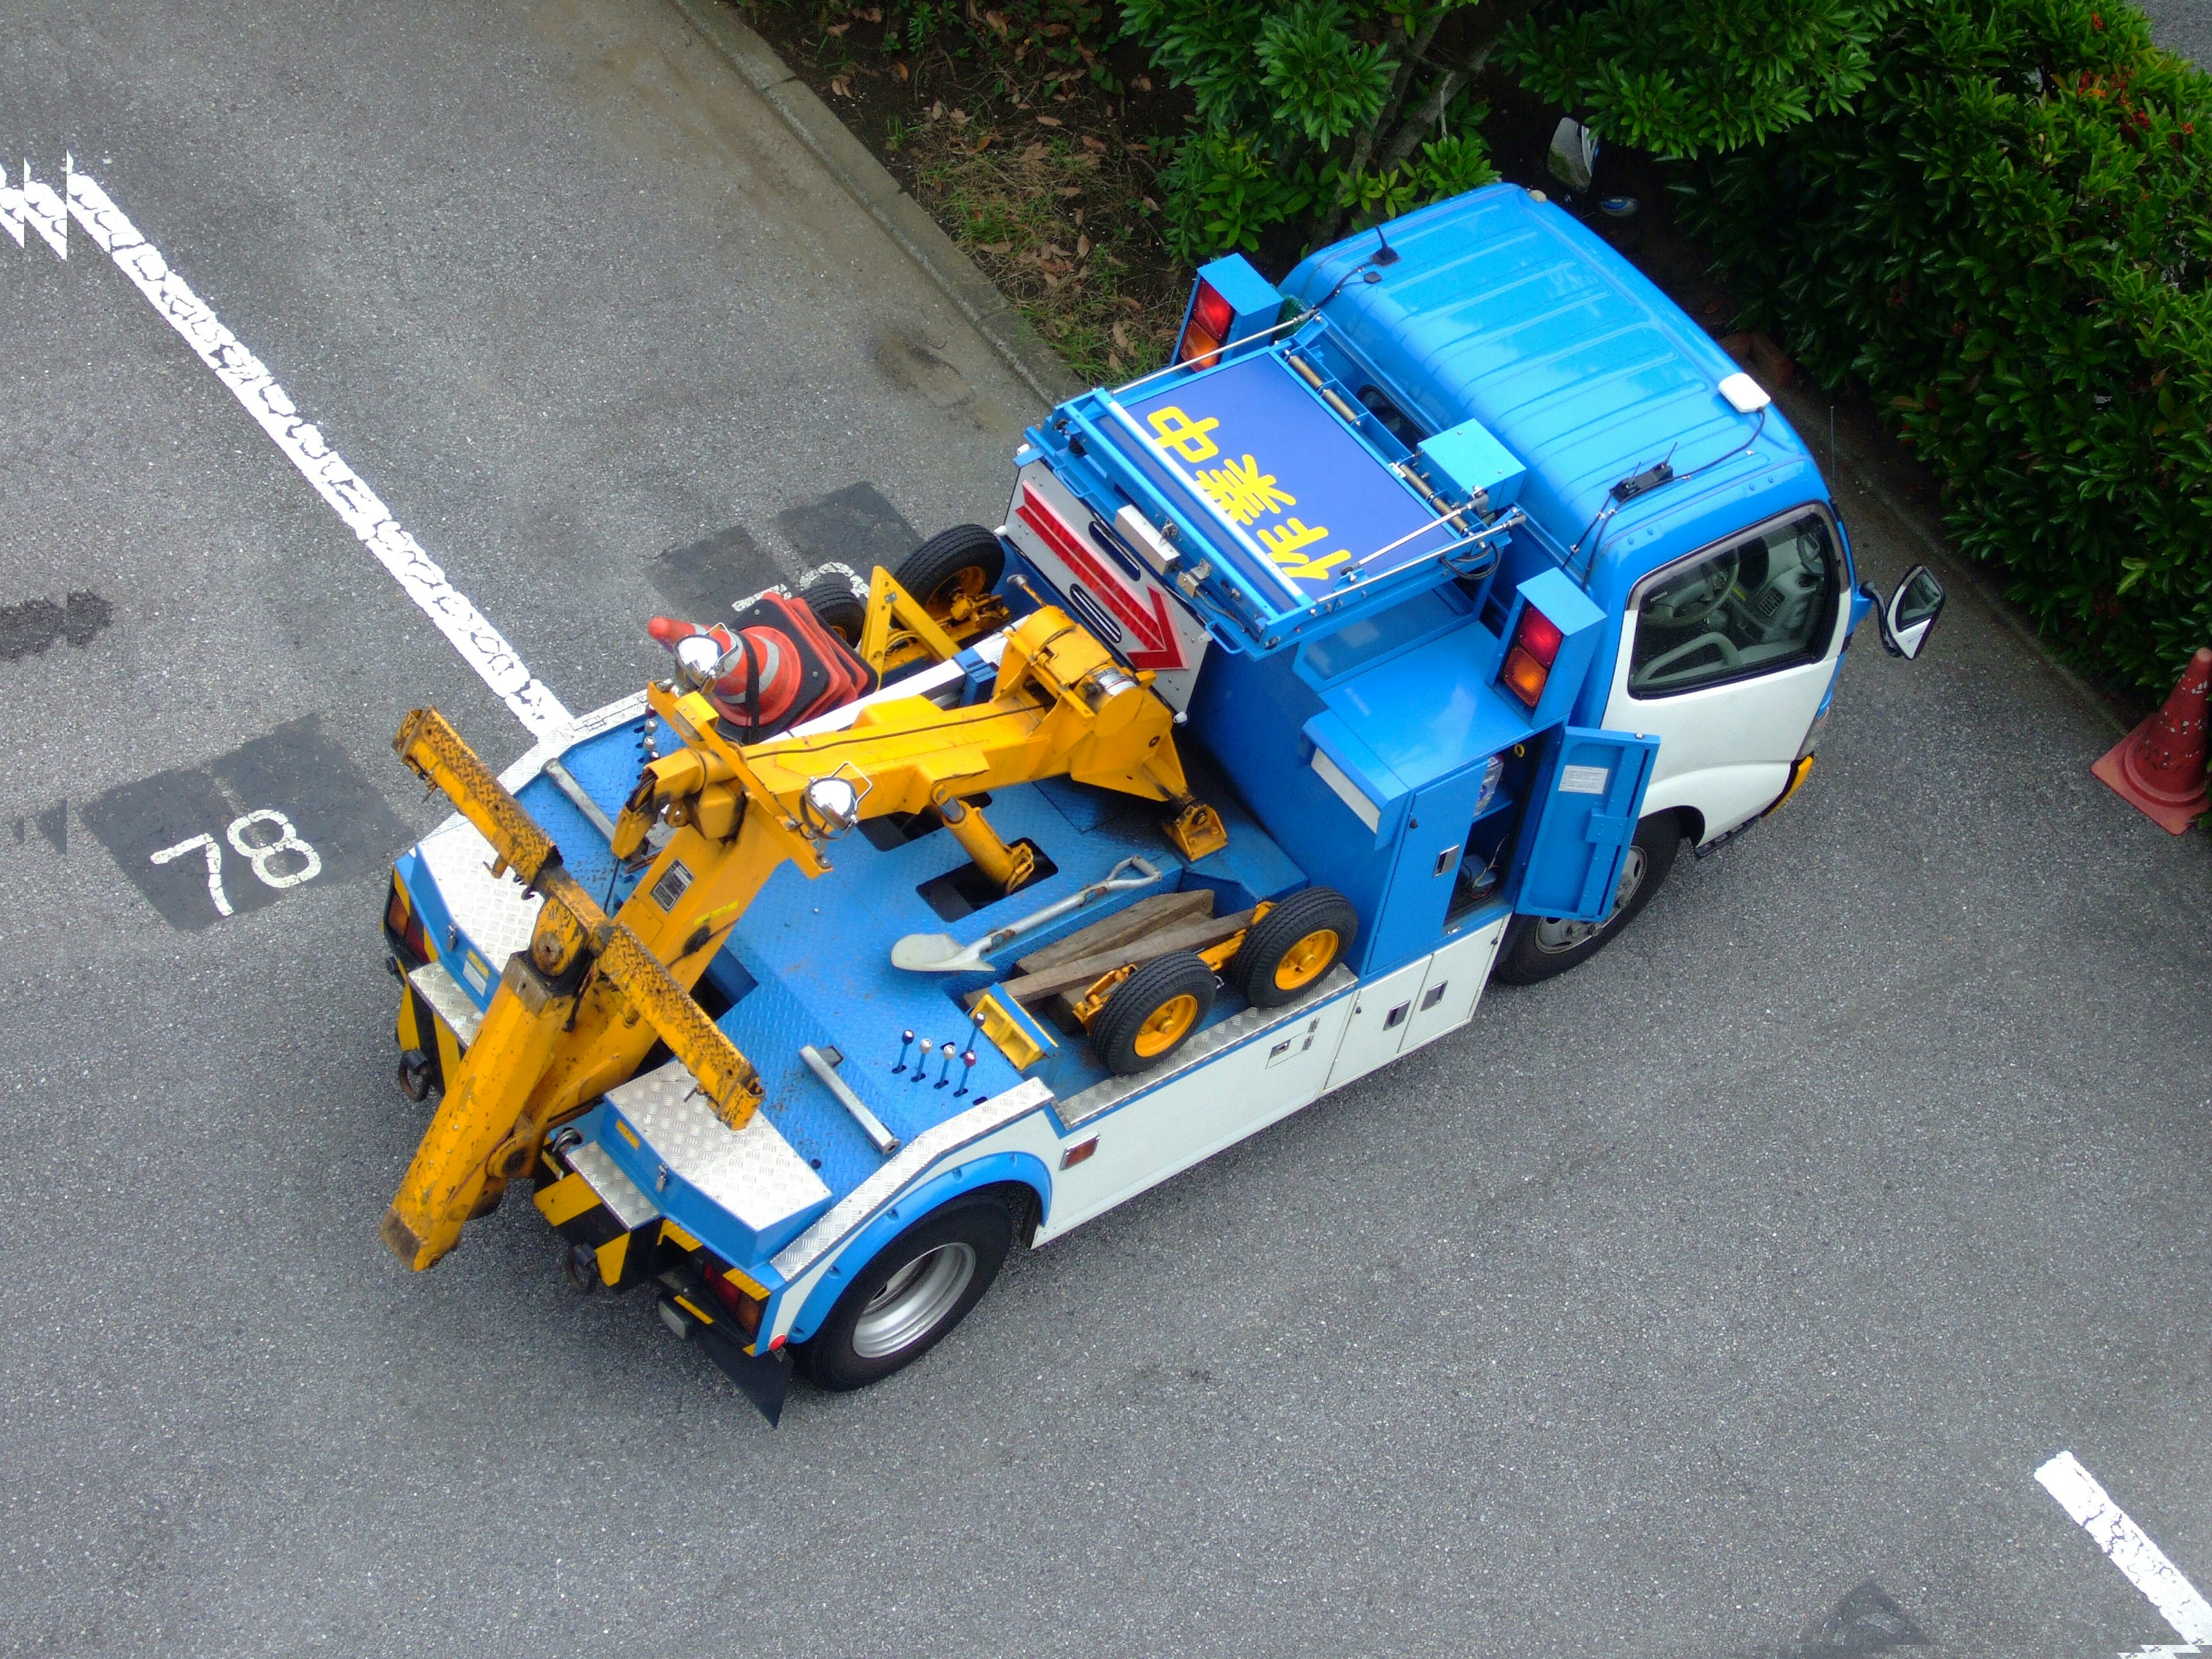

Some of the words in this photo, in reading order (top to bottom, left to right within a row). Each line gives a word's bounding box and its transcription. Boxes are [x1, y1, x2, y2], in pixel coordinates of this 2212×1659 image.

[1147, 406, 1352, 581] 作業中
[150, 809, 322, 917] 78
